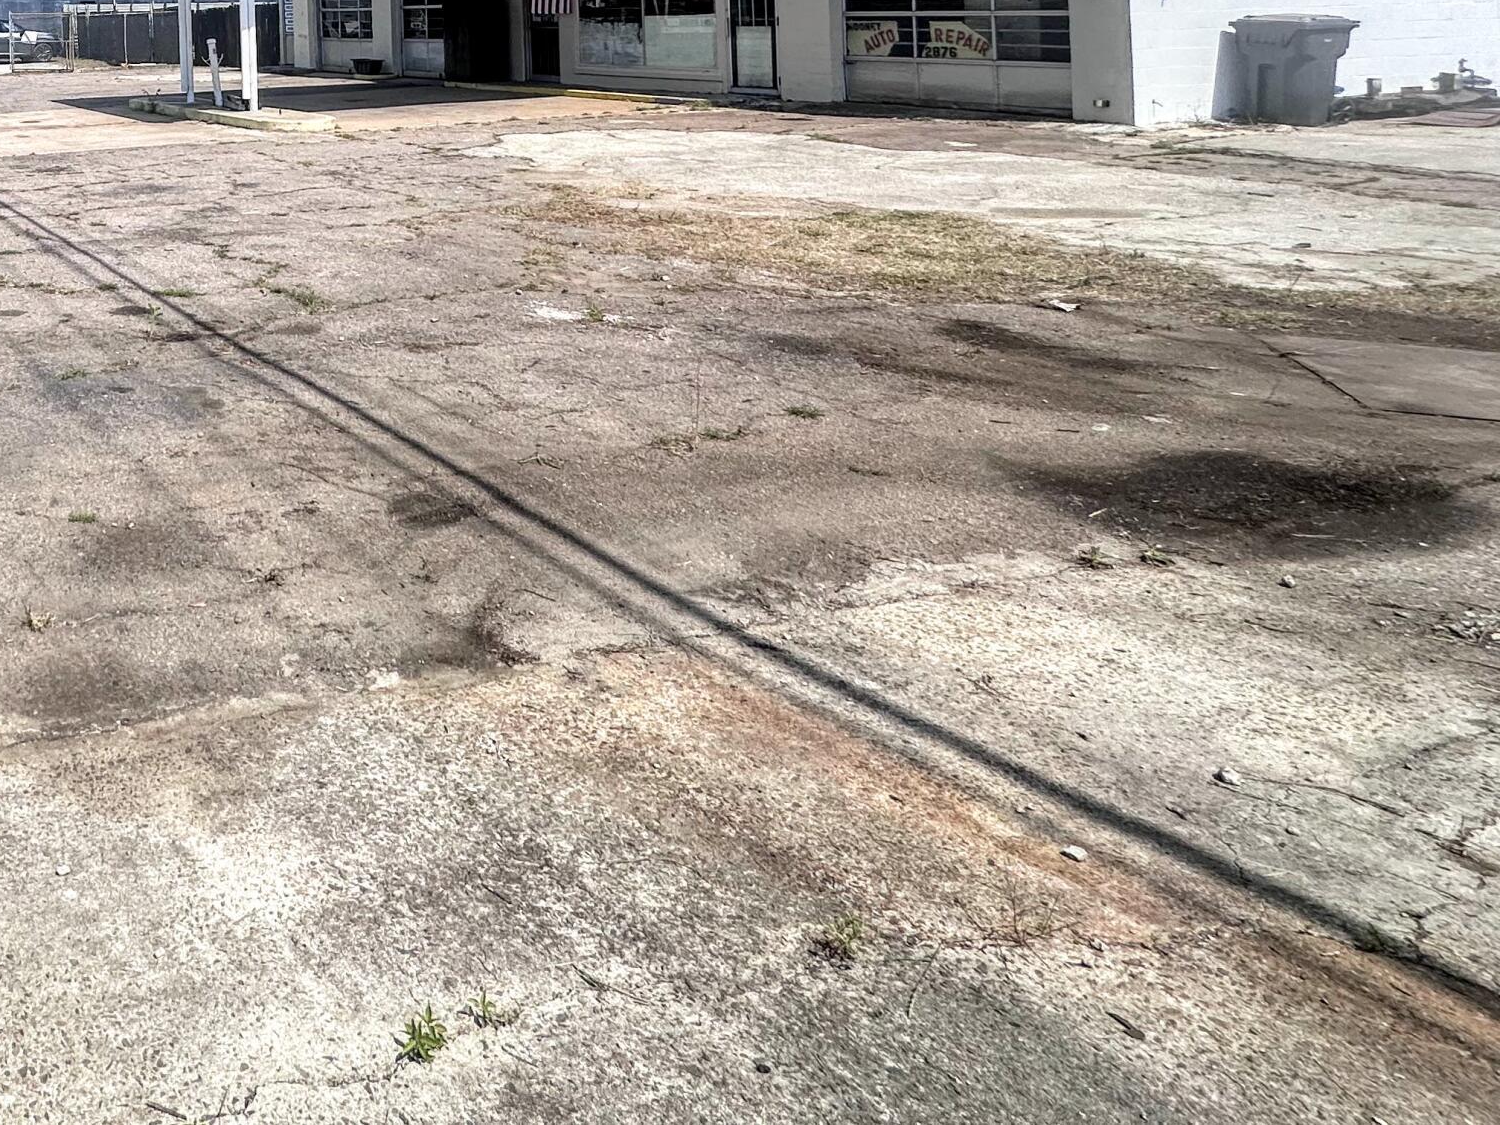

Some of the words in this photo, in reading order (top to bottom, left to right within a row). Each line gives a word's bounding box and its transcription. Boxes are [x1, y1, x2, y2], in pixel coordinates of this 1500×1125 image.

[864, 29, 896, 53] AUTO
[934, 28, 990, 57] REPAIR
[924, 46, 958, 58] 2876
